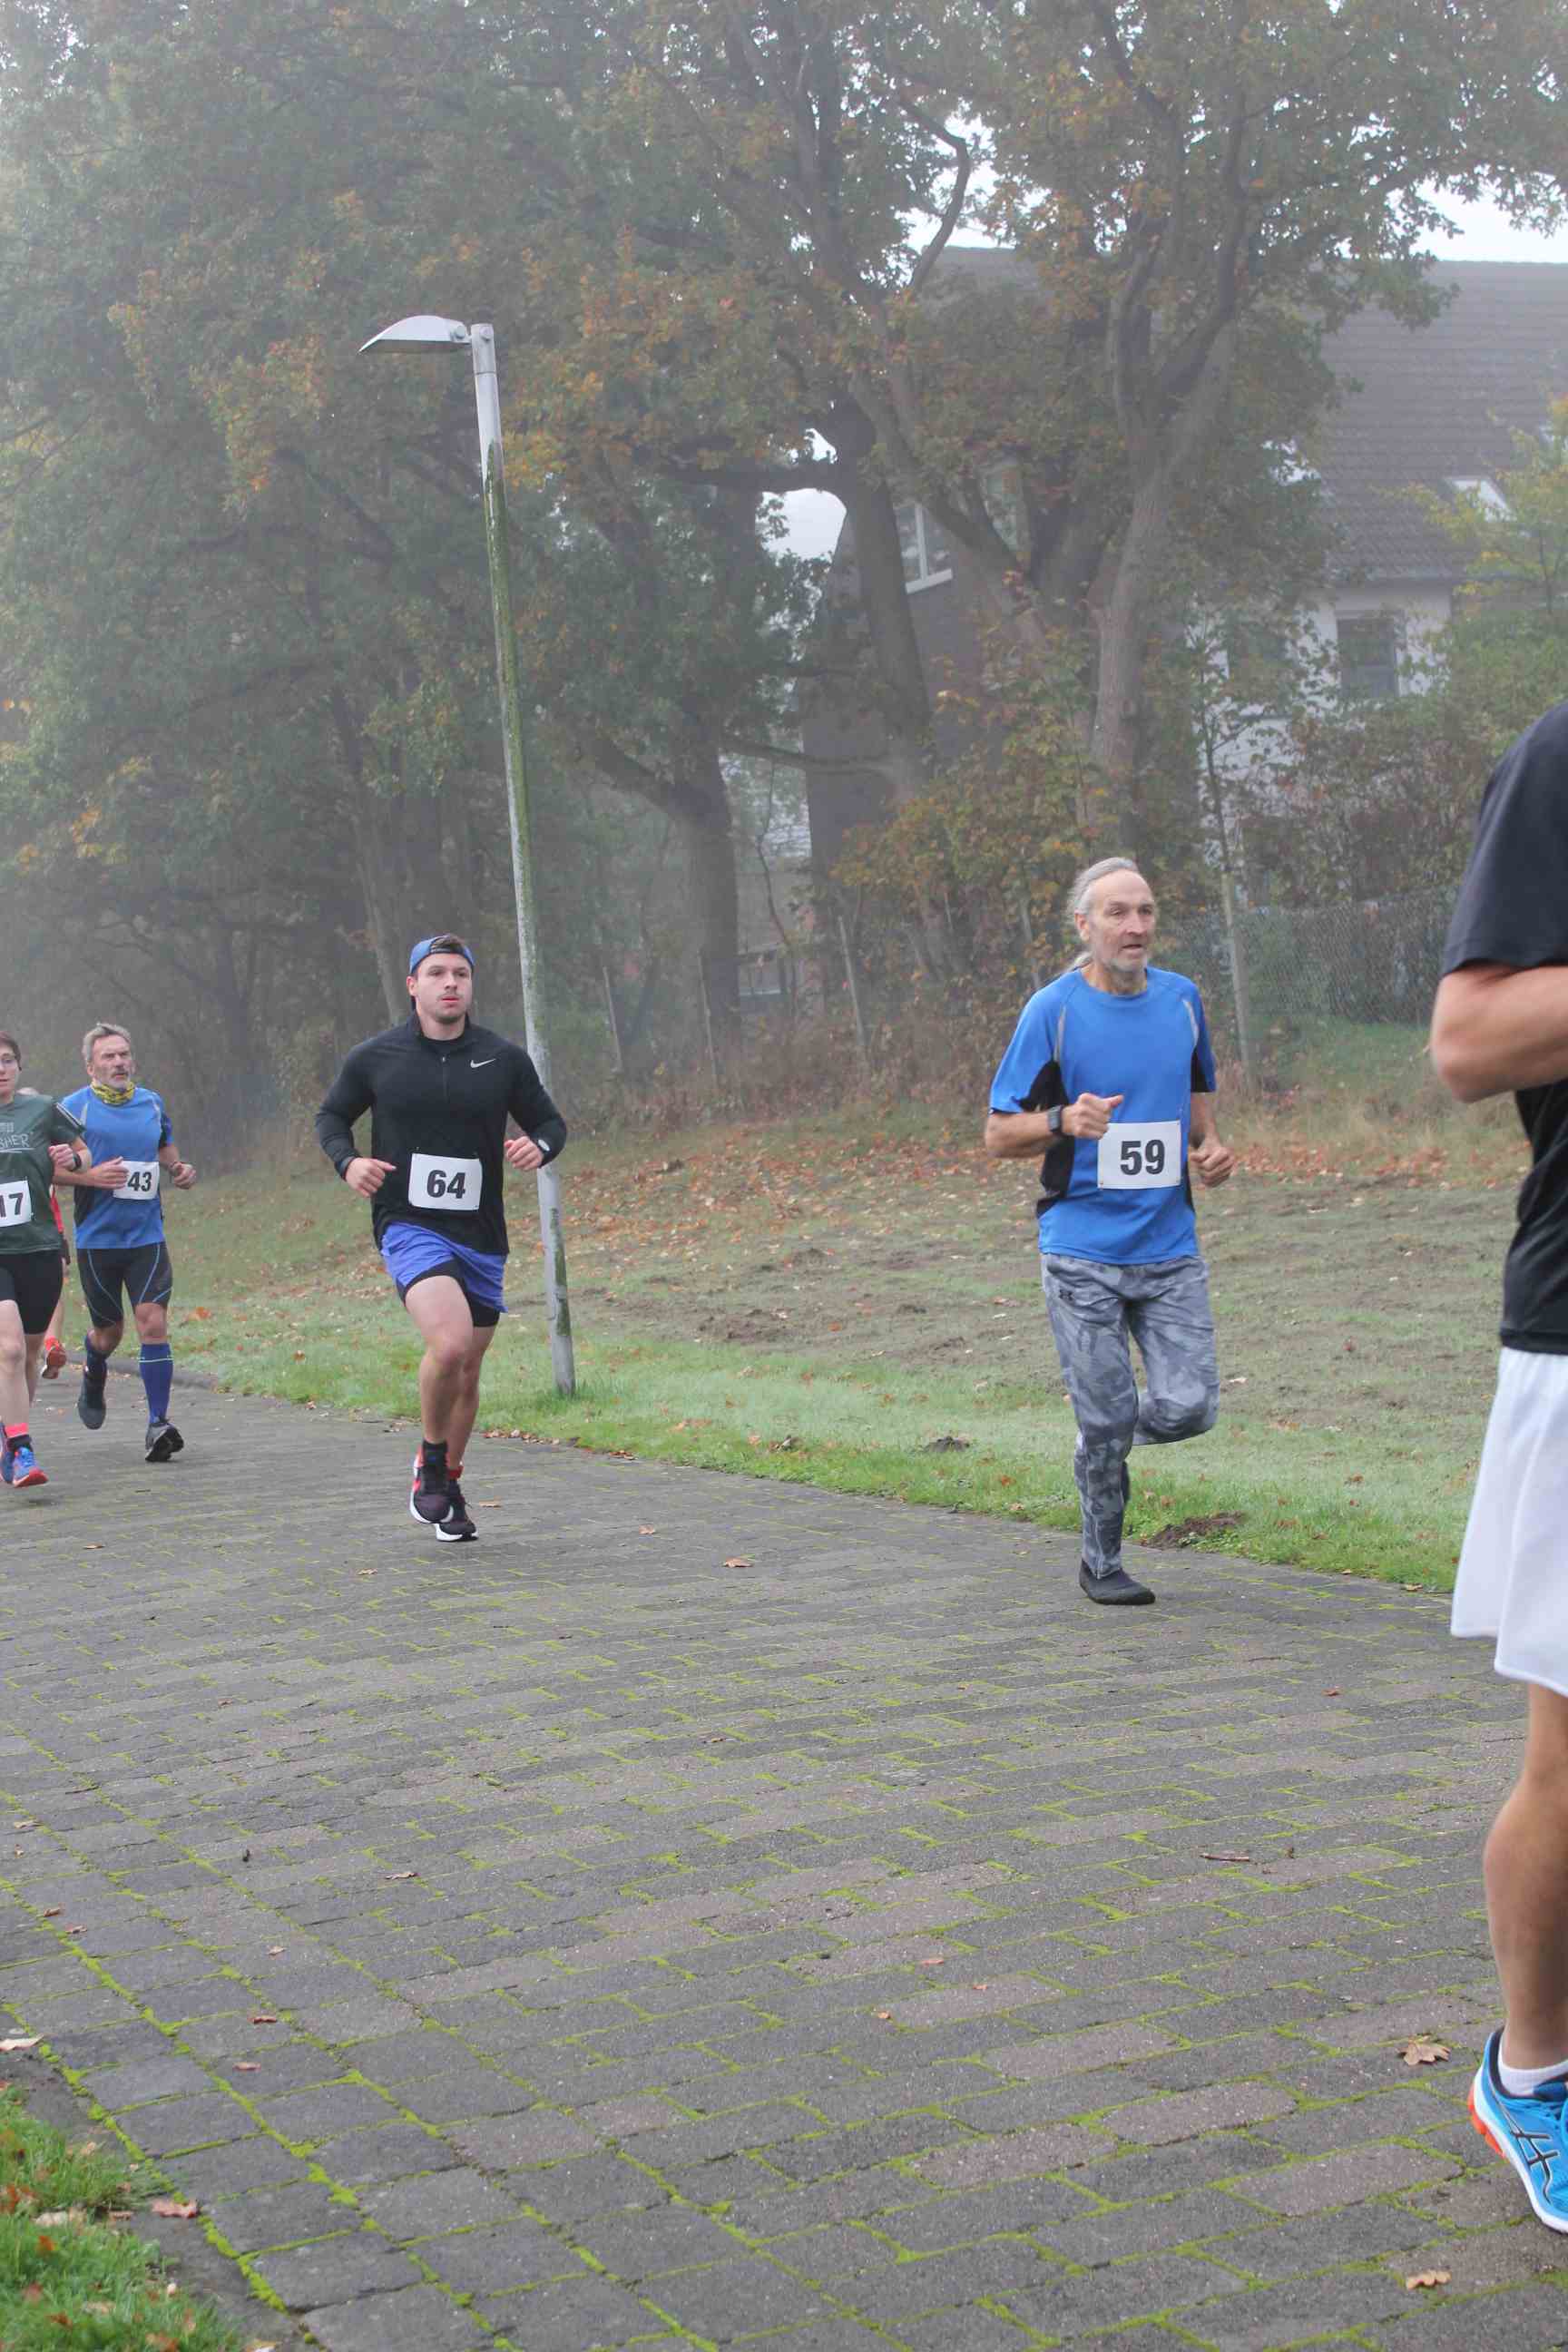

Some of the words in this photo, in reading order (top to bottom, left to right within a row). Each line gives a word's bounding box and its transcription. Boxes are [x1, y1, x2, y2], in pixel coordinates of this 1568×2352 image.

[1120, 1139, 1165, 1175] 59
[127, 1171, 152, 1192] 43
[426, 1169, 466, 1199] 64
